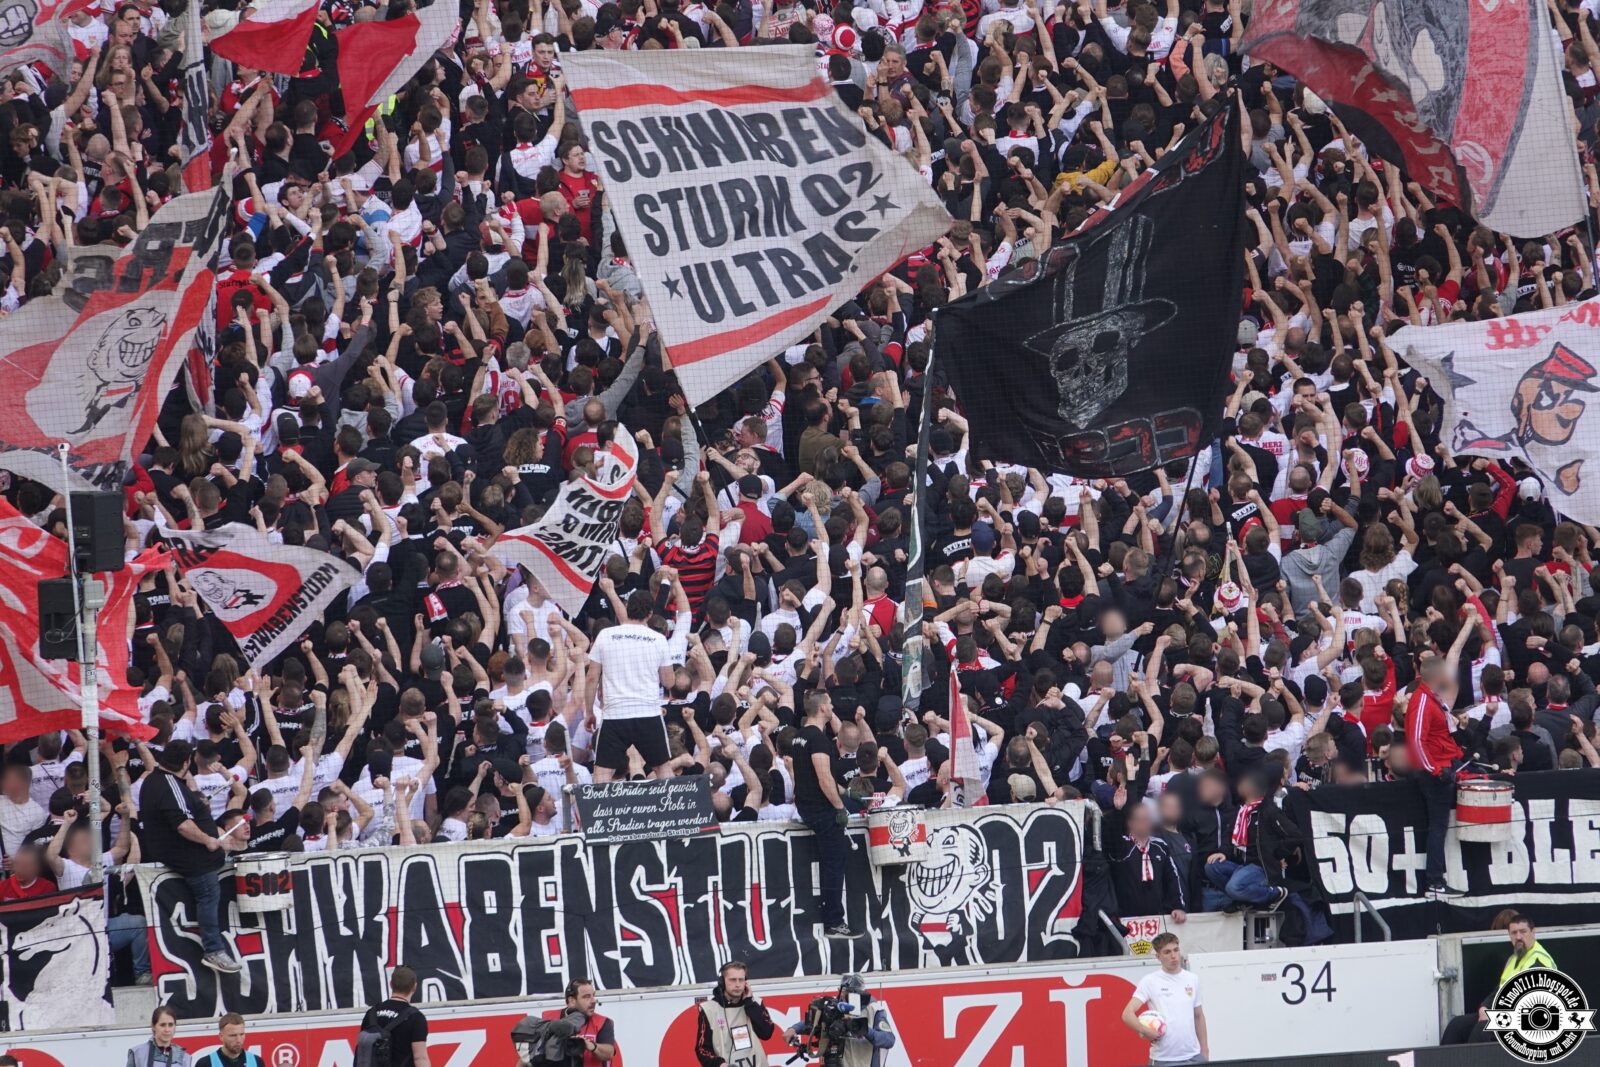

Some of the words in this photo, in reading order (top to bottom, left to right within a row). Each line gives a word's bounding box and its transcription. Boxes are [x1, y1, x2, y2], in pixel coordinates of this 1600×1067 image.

[591, 106, 868, 184] SCHWABEN
[634, 174, 808, 257] STURM
[801, 160, 884, 217] 02
[679, 210, 884, 325] ULTRAS
[242, 562, 340, 664] CHWABENSTURM
[582, 783, 610, 800] Doch
[611, 781, 648, 798] Brüder
[649, 779, 668, 795] seid
[668, 781, 699, 798] gewiss,
[593, 803, 613, 818] dass
[614, 804, 631, 816] wir
[632, 805, 658, 814] euren
[658, 796, 686, 812] Stolz
[687, 799, 697, 809] in
[587, 820, 605, 834] alle
[606, 817, 646, 833] Stadien
[647, 818, 676, 832] tragen
[677, 812, 714, 826] werden!
[667, 827, 700, 837] Stuttgart
[968, 807, 1082, 964] 02
[1281, 961, 1338, 1005] 34
